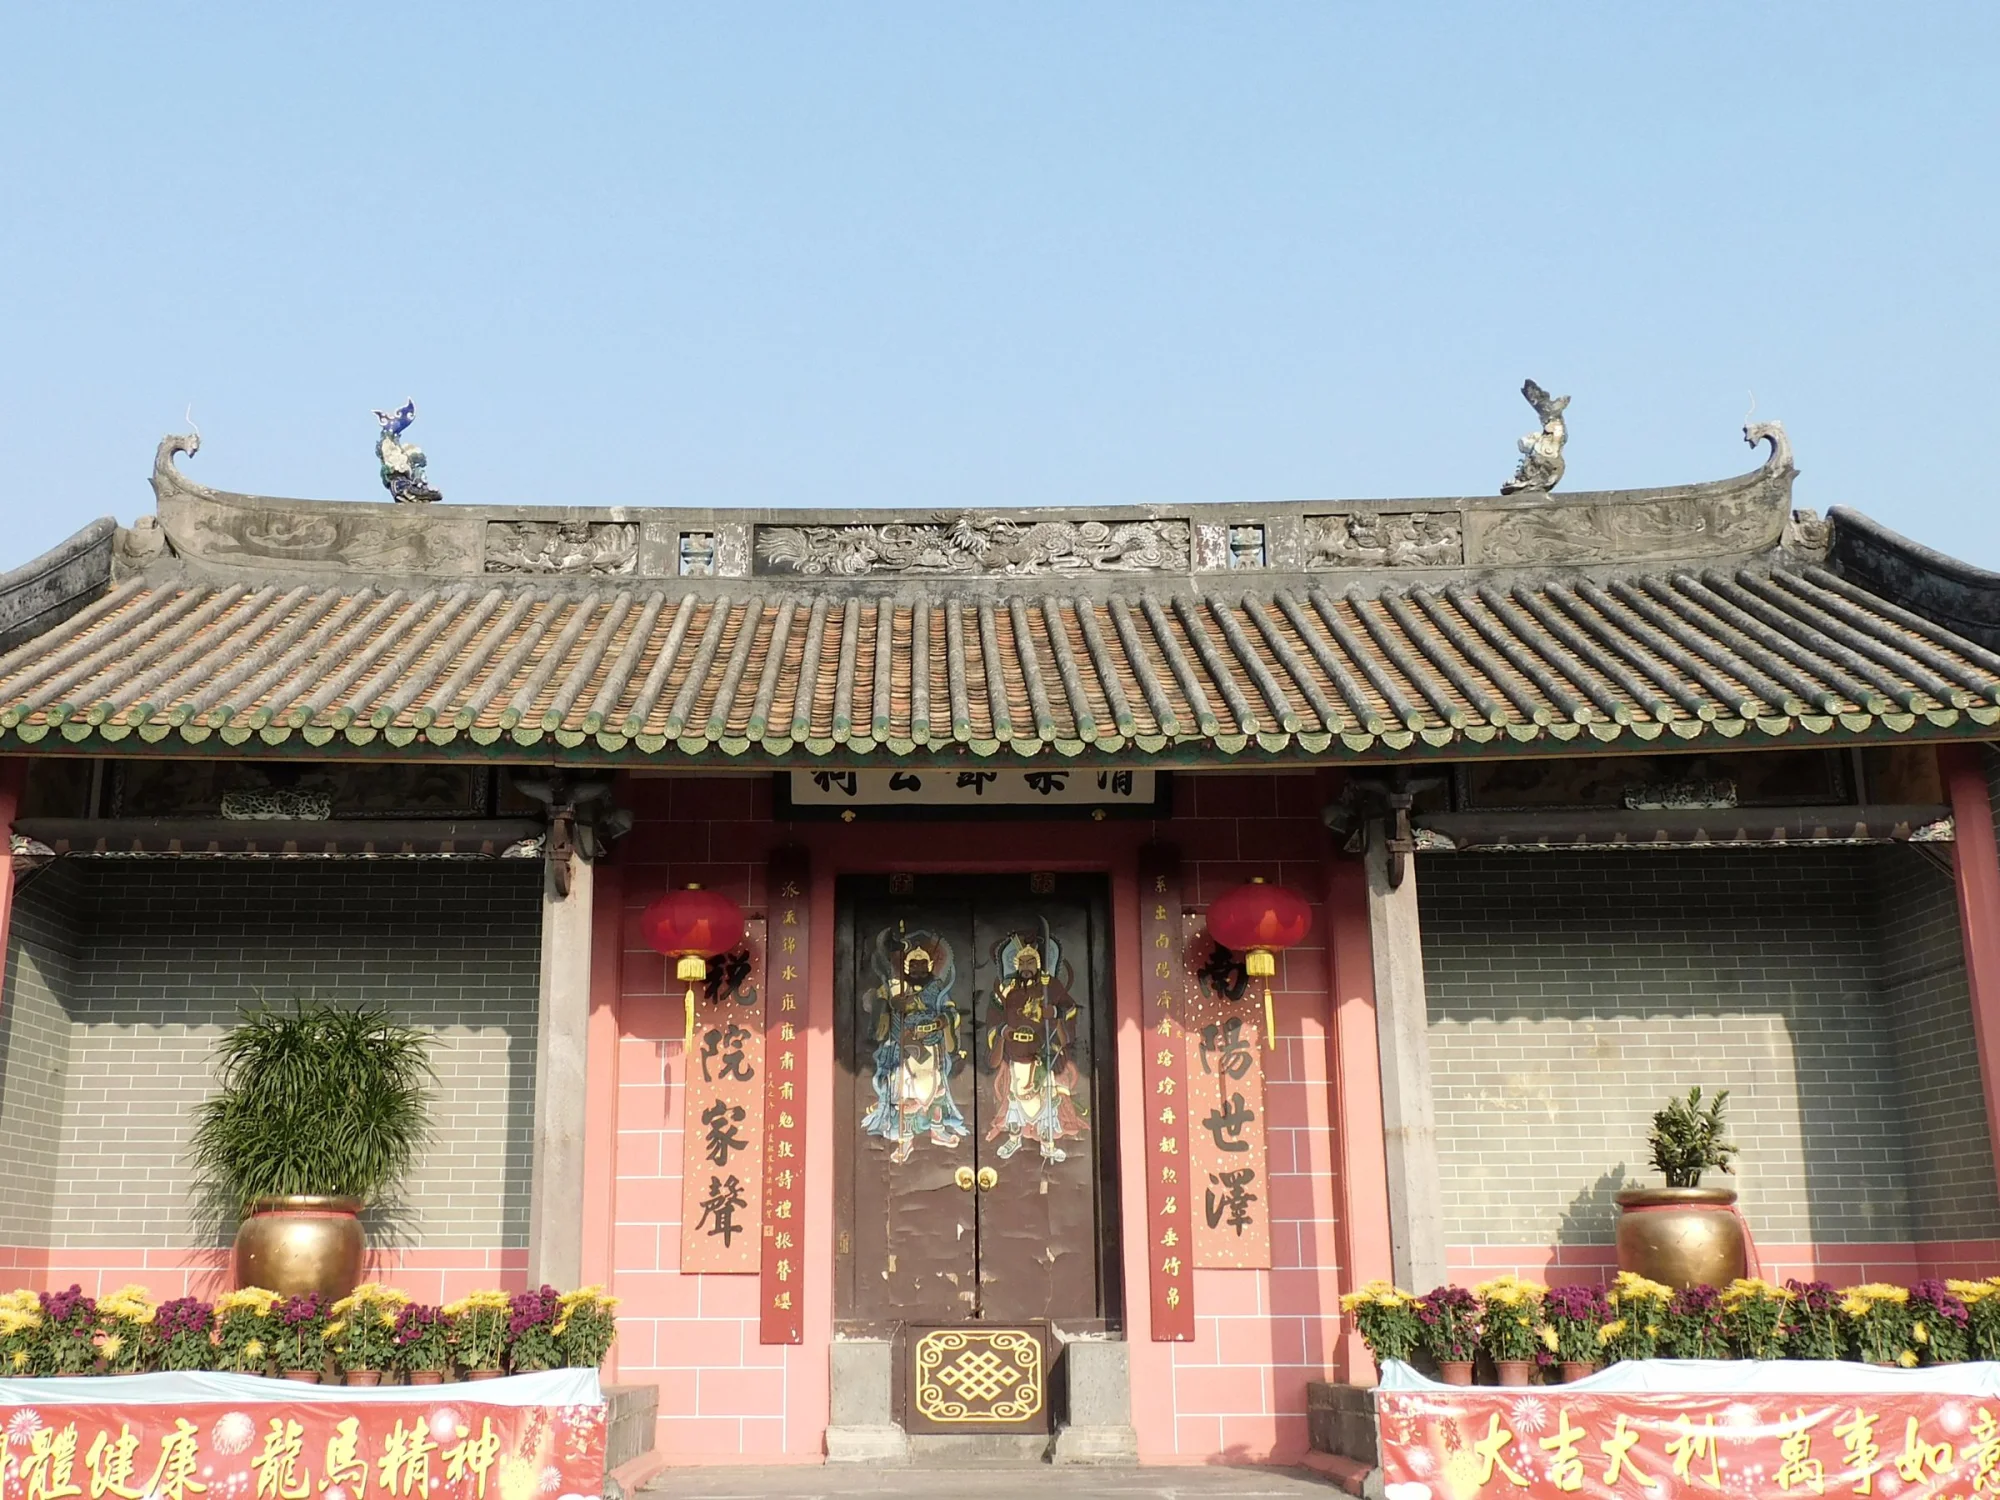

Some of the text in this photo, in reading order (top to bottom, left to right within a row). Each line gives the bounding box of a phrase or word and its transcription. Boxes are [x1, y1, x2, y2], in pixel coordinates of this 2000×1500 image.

[0, 1416, 501, 1500] 體健康 龍馬精神
[1474, 1410, 1722, 1493] 大吉大利
